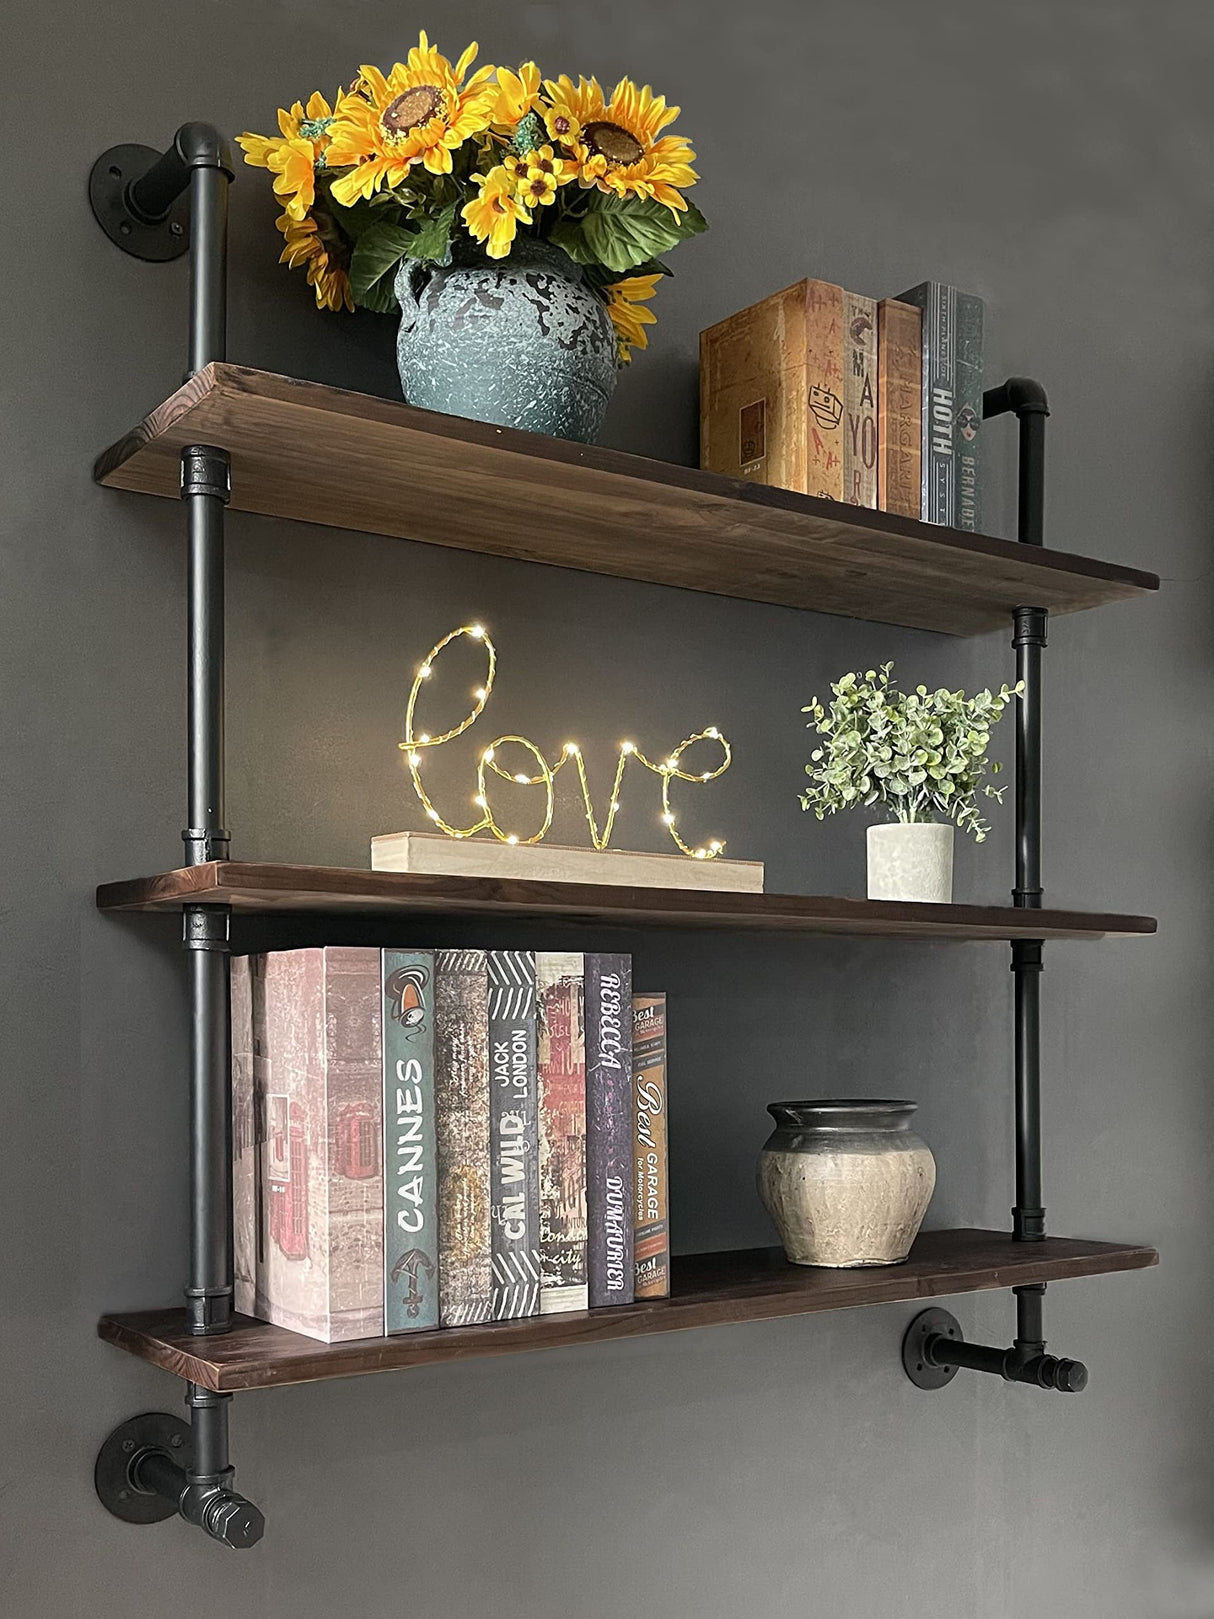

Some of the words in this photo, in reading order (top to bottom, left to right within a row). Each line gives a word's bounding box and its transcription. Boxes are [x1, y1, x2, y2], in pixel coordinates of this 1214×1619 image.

[932, 386, 953, 455] HOTH
[398, 625, 732, 858] love
[599, 973, 621, 1069] REBECCA
[635, 1016, 664, 1032] GARAGE
[493, 1041, 510, 1088] JACK
[511, 1029, 528, 1099] LONDON
[396, 1058, 424, 1233] CANNES
[636, 1075, 663, 1149] Best
[499, 1113, 526, 1185] WILD
[502, 1191, 526, 1241] CAL
[636, 1171, 645, 1221] Motorcycles
[646, 1152, 659, 1220] GARAGE
[605, 1175, 625, 1291] DUMAURIER
[637, 1267, 666, 1284] GARAGE
